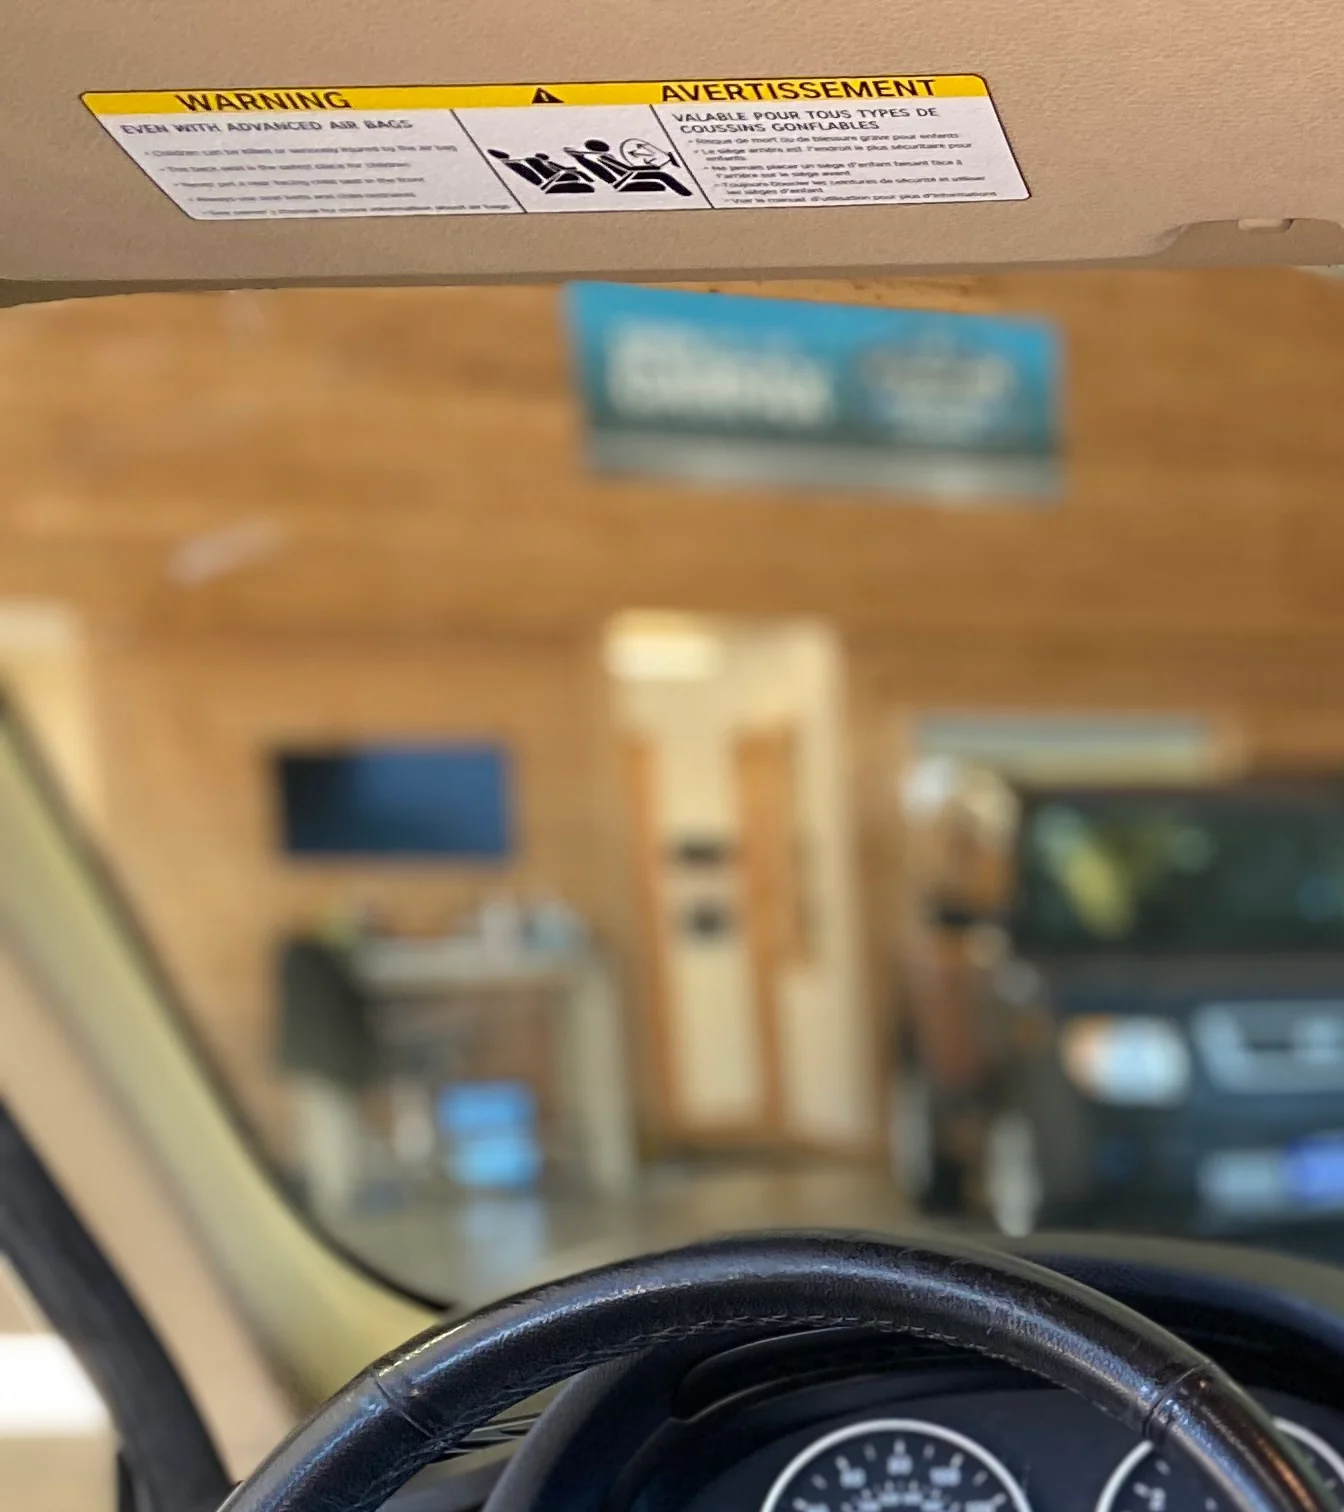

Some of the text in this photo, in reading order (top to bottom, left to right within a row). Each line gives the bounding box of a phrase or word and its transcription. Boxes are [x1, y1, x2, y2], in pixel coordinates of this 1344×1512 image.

[662, 79, 936, 102] AVERTISSEMENT
[176, 91, 352, 112] WARNING
[672, 107, 940, 122] VALABLE POUR TOUS TYPES DE
[120, 119, 413, 134] EVEN WITH ADVANCED AIR BAGS
[680, 121, 880, 133] COUSSINS GONFLABLES
